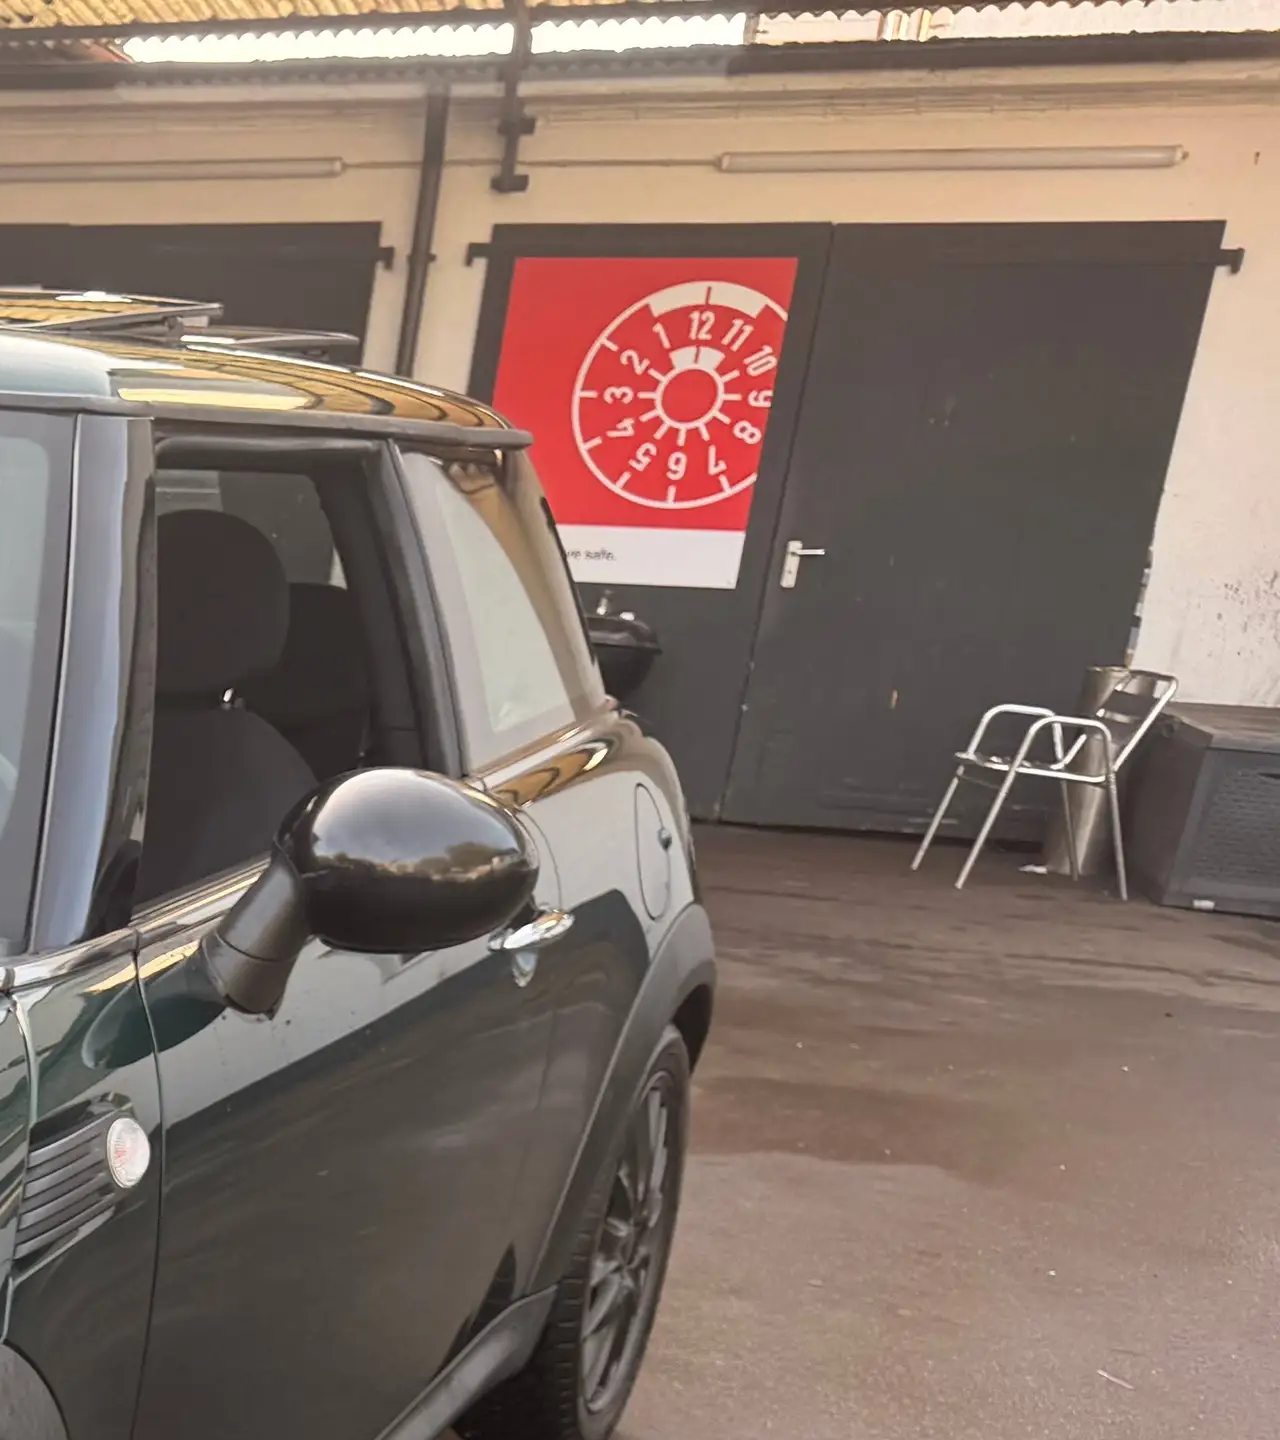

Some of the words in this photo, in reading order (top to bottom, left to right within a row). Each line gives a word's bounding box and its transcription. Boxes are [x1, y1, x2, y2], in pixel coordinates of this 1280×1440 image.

[652, 322, 671, 349] 1
[689, 310, 715, 341] 12
[721, 318, 754, 352] 11
[619, 349, 651, 376] 2
[743, 344, 778, 377] 10
[603, 385, 634, 404] 3
[747, 389, 773, 408] 9
[606, 418, 635, 437] 4
[733, 420, 762, 445] 8
[628, 442, 657, 472] 5
[666, 451, 687, 481] 6
[707, 444, 728, 476] 7
